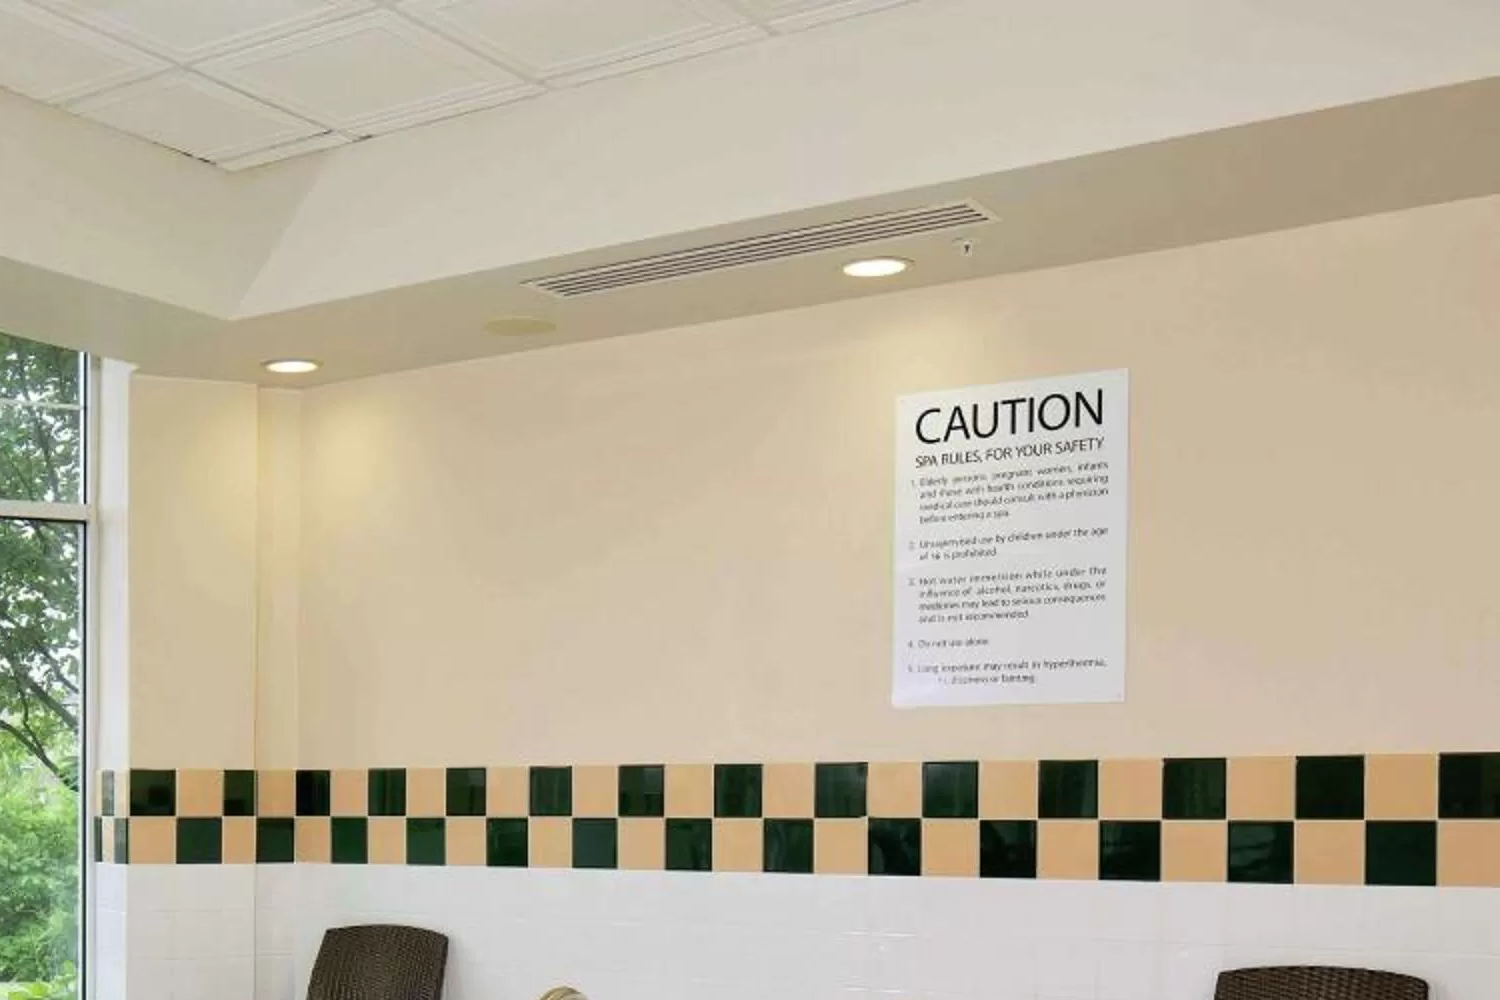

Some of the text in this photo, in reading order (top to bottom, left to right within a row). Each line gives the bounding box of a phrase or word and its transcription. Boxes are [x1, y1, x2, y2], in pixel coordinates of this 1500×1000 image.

[915, 388, 1103, 445] CAUTION
[915, 453, 937, 468] SPA
[985, 446, 1012, 461] FOR
[1015, 441, 1051, 458] YOUR
[1055, 436, 1104, 454] SAFETY
